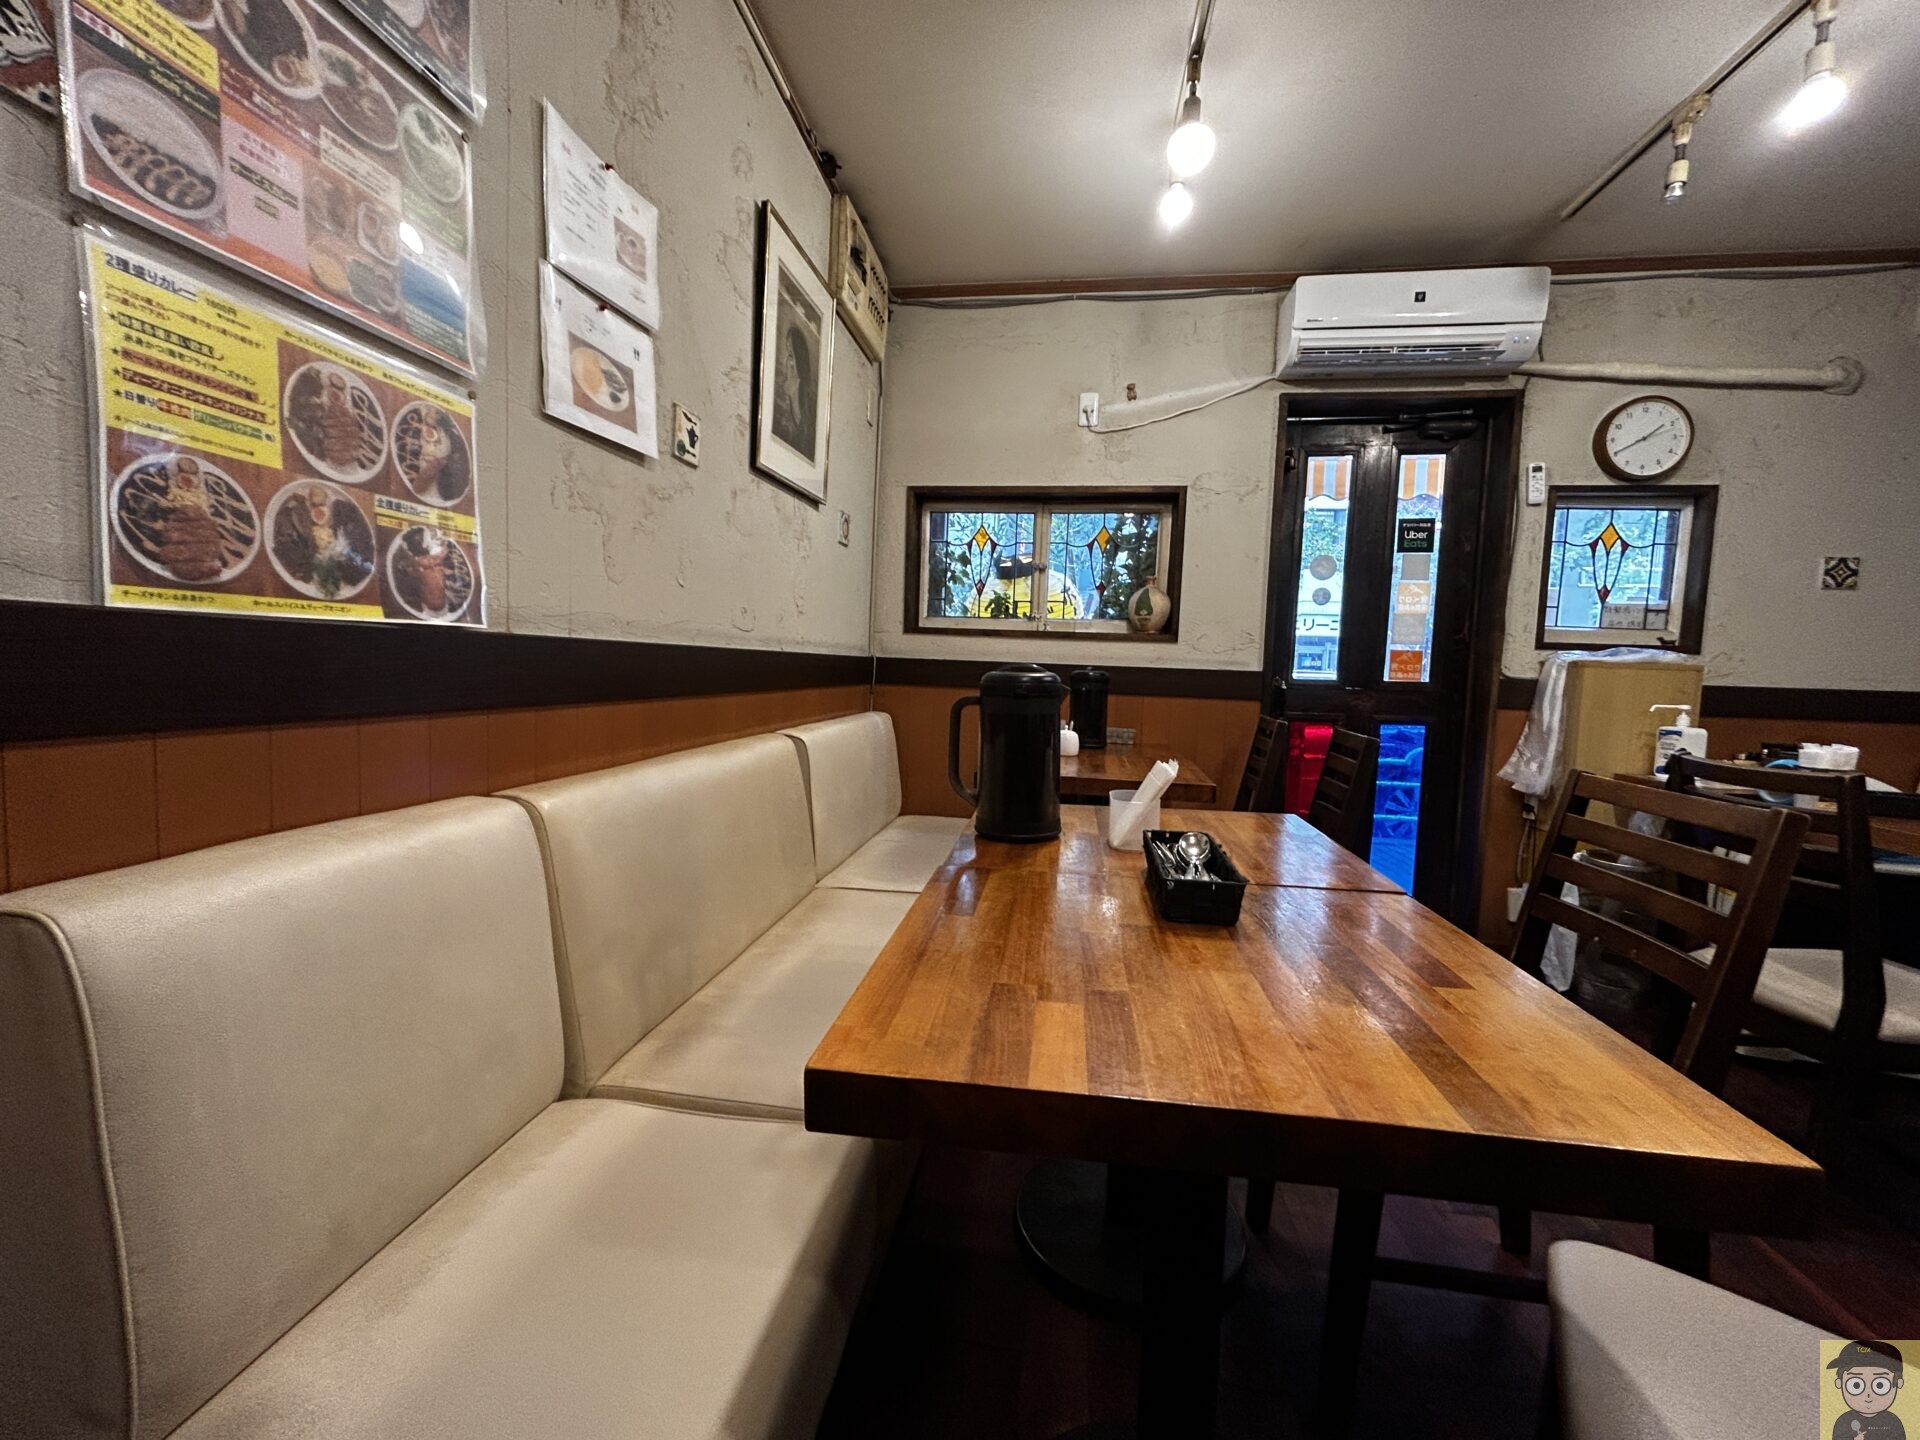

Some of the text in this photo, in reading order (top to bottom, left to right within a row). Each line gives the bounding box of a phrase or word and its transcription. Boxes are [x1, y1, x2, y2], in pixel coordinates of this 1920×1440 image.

[105, 252, 196, 301] 2種盛りカレー
[1404, 530, 1428, 539] Uber
[1404, 539, 1427, 548] Eats
[1297, 618, 1338, 631] リーニ
